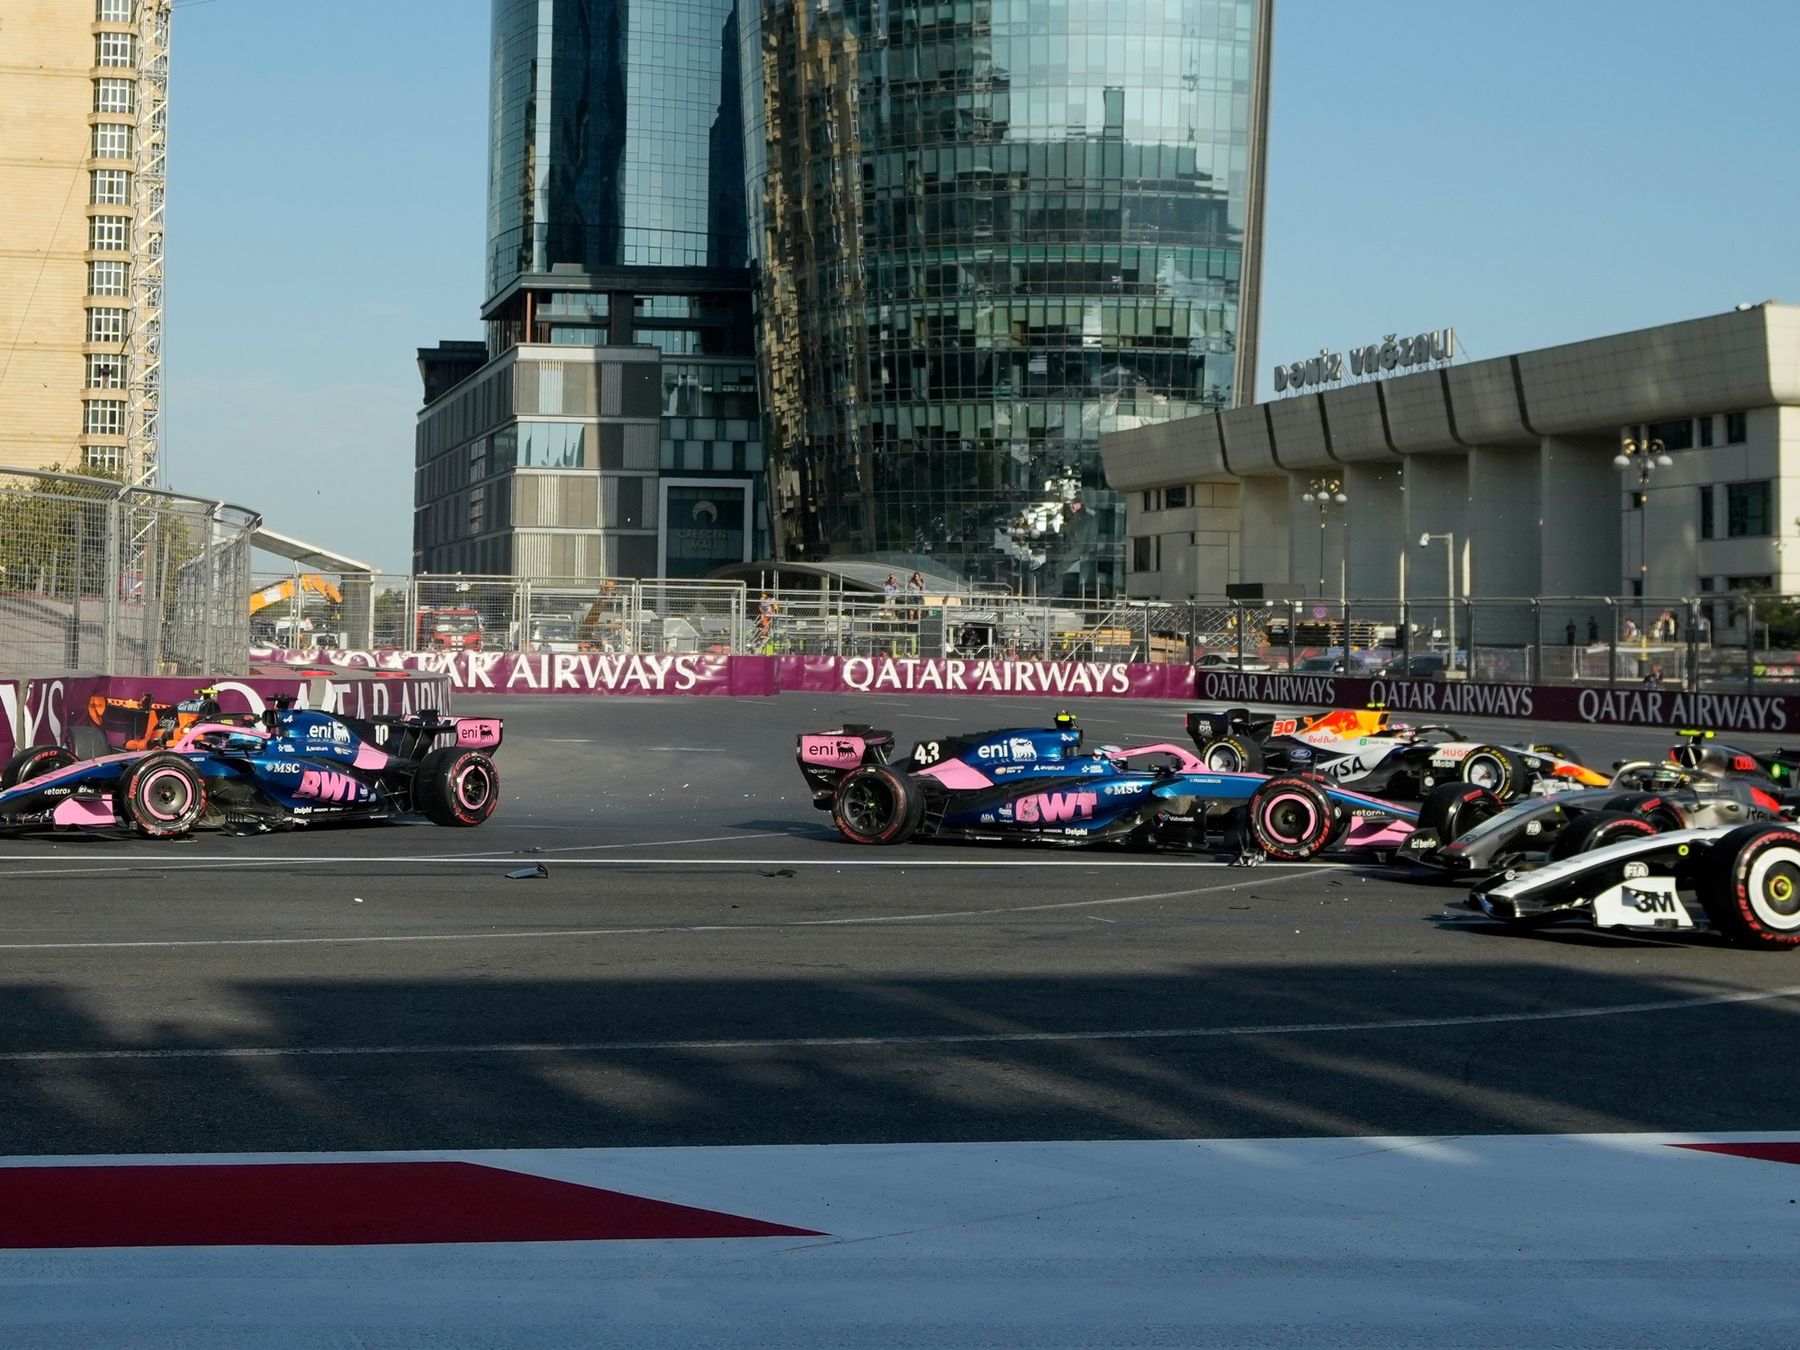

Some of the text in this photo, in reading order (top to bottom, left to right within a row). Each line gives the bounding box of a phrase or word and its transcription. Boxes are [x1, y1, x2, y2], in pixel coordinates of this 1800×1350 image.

[1349, 326, 1454, 377] VAĞZALI
[507, 653, 698, 690] AIRWAYS
[843, 657, 1130, 693] QATAR AIRWAYS
[1205, 673, 1335, 705] QATAR AIRWAYS
[1369, 680, 1533, 716] QATAR AIRWAYS
[1578, 689, 1787, 731] QATAR AIRWAYS
[309, 721, 332, 738] eni
[374, 724, 389, 747] 10
[461, 724, 478, 739] eni
[1271, 719, 1298, 737] 30
[809, 741, 834, 756] eni
[913, 741, 940, 766] 43
[978, 740, 1009, 758] eni
[273, 762, 300, 774] MSC
[1113, 784, 1143, 796] MSC
[1015, 792, 1098, 823] BWT
[1065, 828, 1088, 837] Delphi
